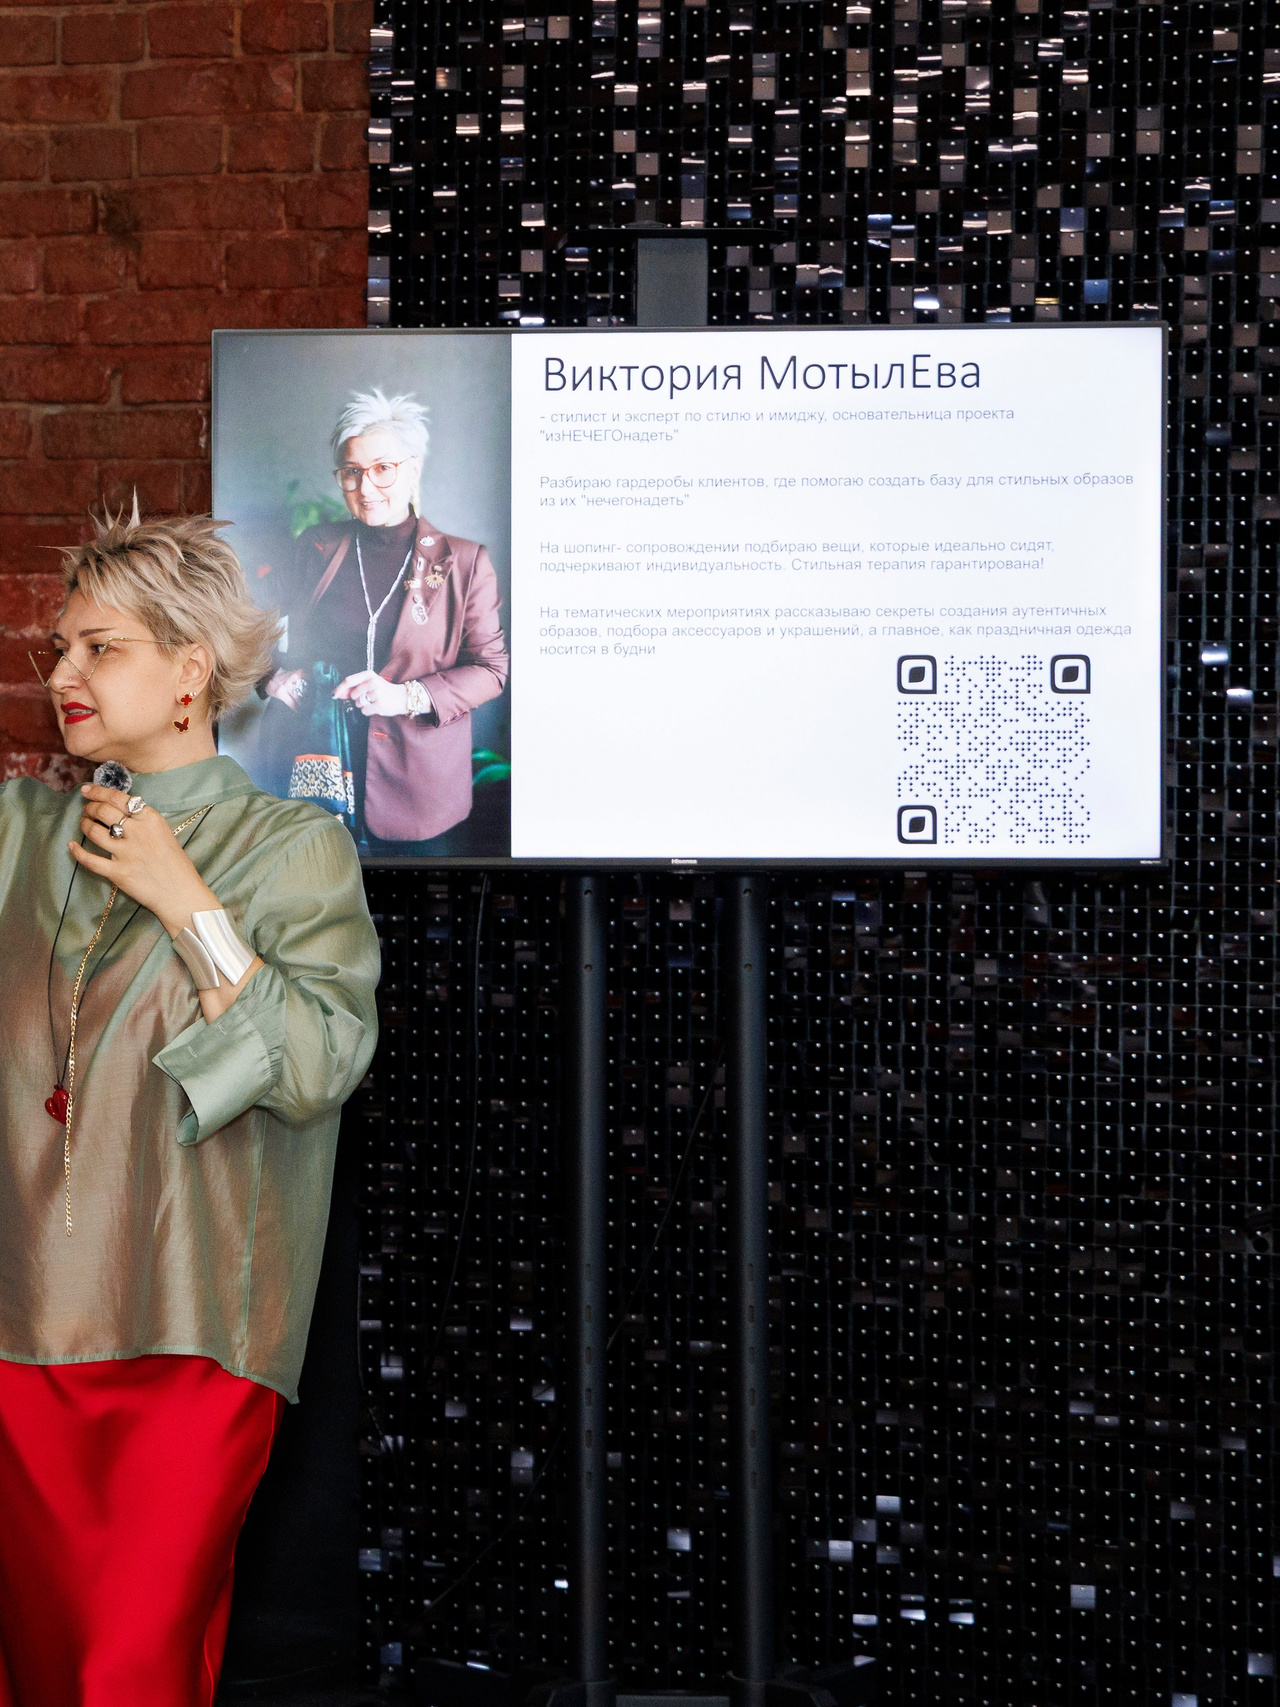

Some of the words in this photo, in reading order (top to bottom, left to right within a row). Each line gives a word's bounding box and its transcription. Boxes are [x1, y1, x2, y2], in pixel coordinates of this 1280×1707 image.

[544, 356, 741, 400] Виктория
[760, 353, 980, 391] МотылЕва
[550, 413, 608, 423] стилист
[611, 413, 621, 422] и
[624, 412, 680, 424] эксперт
[684, 412, 702, 422] по
[705, 412, 752, 421] стилю
[755, 412, 765, 421] и
[768, 412, 828, 424] имиджу,
[832, 410, 952, 421] основательница
[956, 410, 1015, 422] проекта
[539, 429, 679, 443] "изНЕЧЕГОнадеть"
[539, 476, 612, 491] Разбираю
[615, 475, 694, 491] гардеробы
[773, 478, 797, 488] где
[800, 477, 864, 487] помогаю
[867, 477, 926, 488] создать
[929, 474, 963, 489] базу
[965, 476, 994, 487] для
[997, 476, 1069, 485] стильных
[1072, 472, 1134, 487] образов
[539, 497, 556, 506] из
[559, 497, 577, 506] их
[580, 494, 690, 507] "нечегонадеть"
[539, 542, 560, 553] На
[563, 544, 622, 553] шопинг-
[625, 543, 740, 556] сопровождении
[744, 540, 818, 555] подбираю
[821, 543, 865, 554] вещи,
[869, 542, 930, 554] которые
[934, 542, 1006, 553] идеально
[1009, 541, 1055, 552] сидят,
[539, 562, 642, 574] подчеркивают
[646, 561, 786, 574] индивидуальность.
[790, 558, 862, 571] Стильная
[866, 561, 926, 573] терапия
[930, 557, 1045, 573] гарантирована!
[539, 606, 560, 618] На
[563, 609, 663, 618] тематических
[666, 608, 771, 621] мероприятиях
[774, 608, 872, 620] рассказываю
[875, 607, 935, 619] секреты
[939, 607, 1008, 618] создания
[1011, 607, 1107, 620] аутентичных
[539, 625, 602, 639] образов,
[606, 624, 668, 639] подбора
[671, 627, 762, 639] аксессуаров
[766, 627, 775, 636] и
[779, 624, 864, 639] украшений,
[868, 626, 878, 636] а
[881, 626, 944, 636] главное,
[948, 626, 973, 635] как
[976, 626, 1072, 638] праздничная
[1075, 625, 1132, 636] одежда
[539, 645, 597, 655] носится
[600, 645, 610, 655] в
[613, 642, 656, 658] будни
